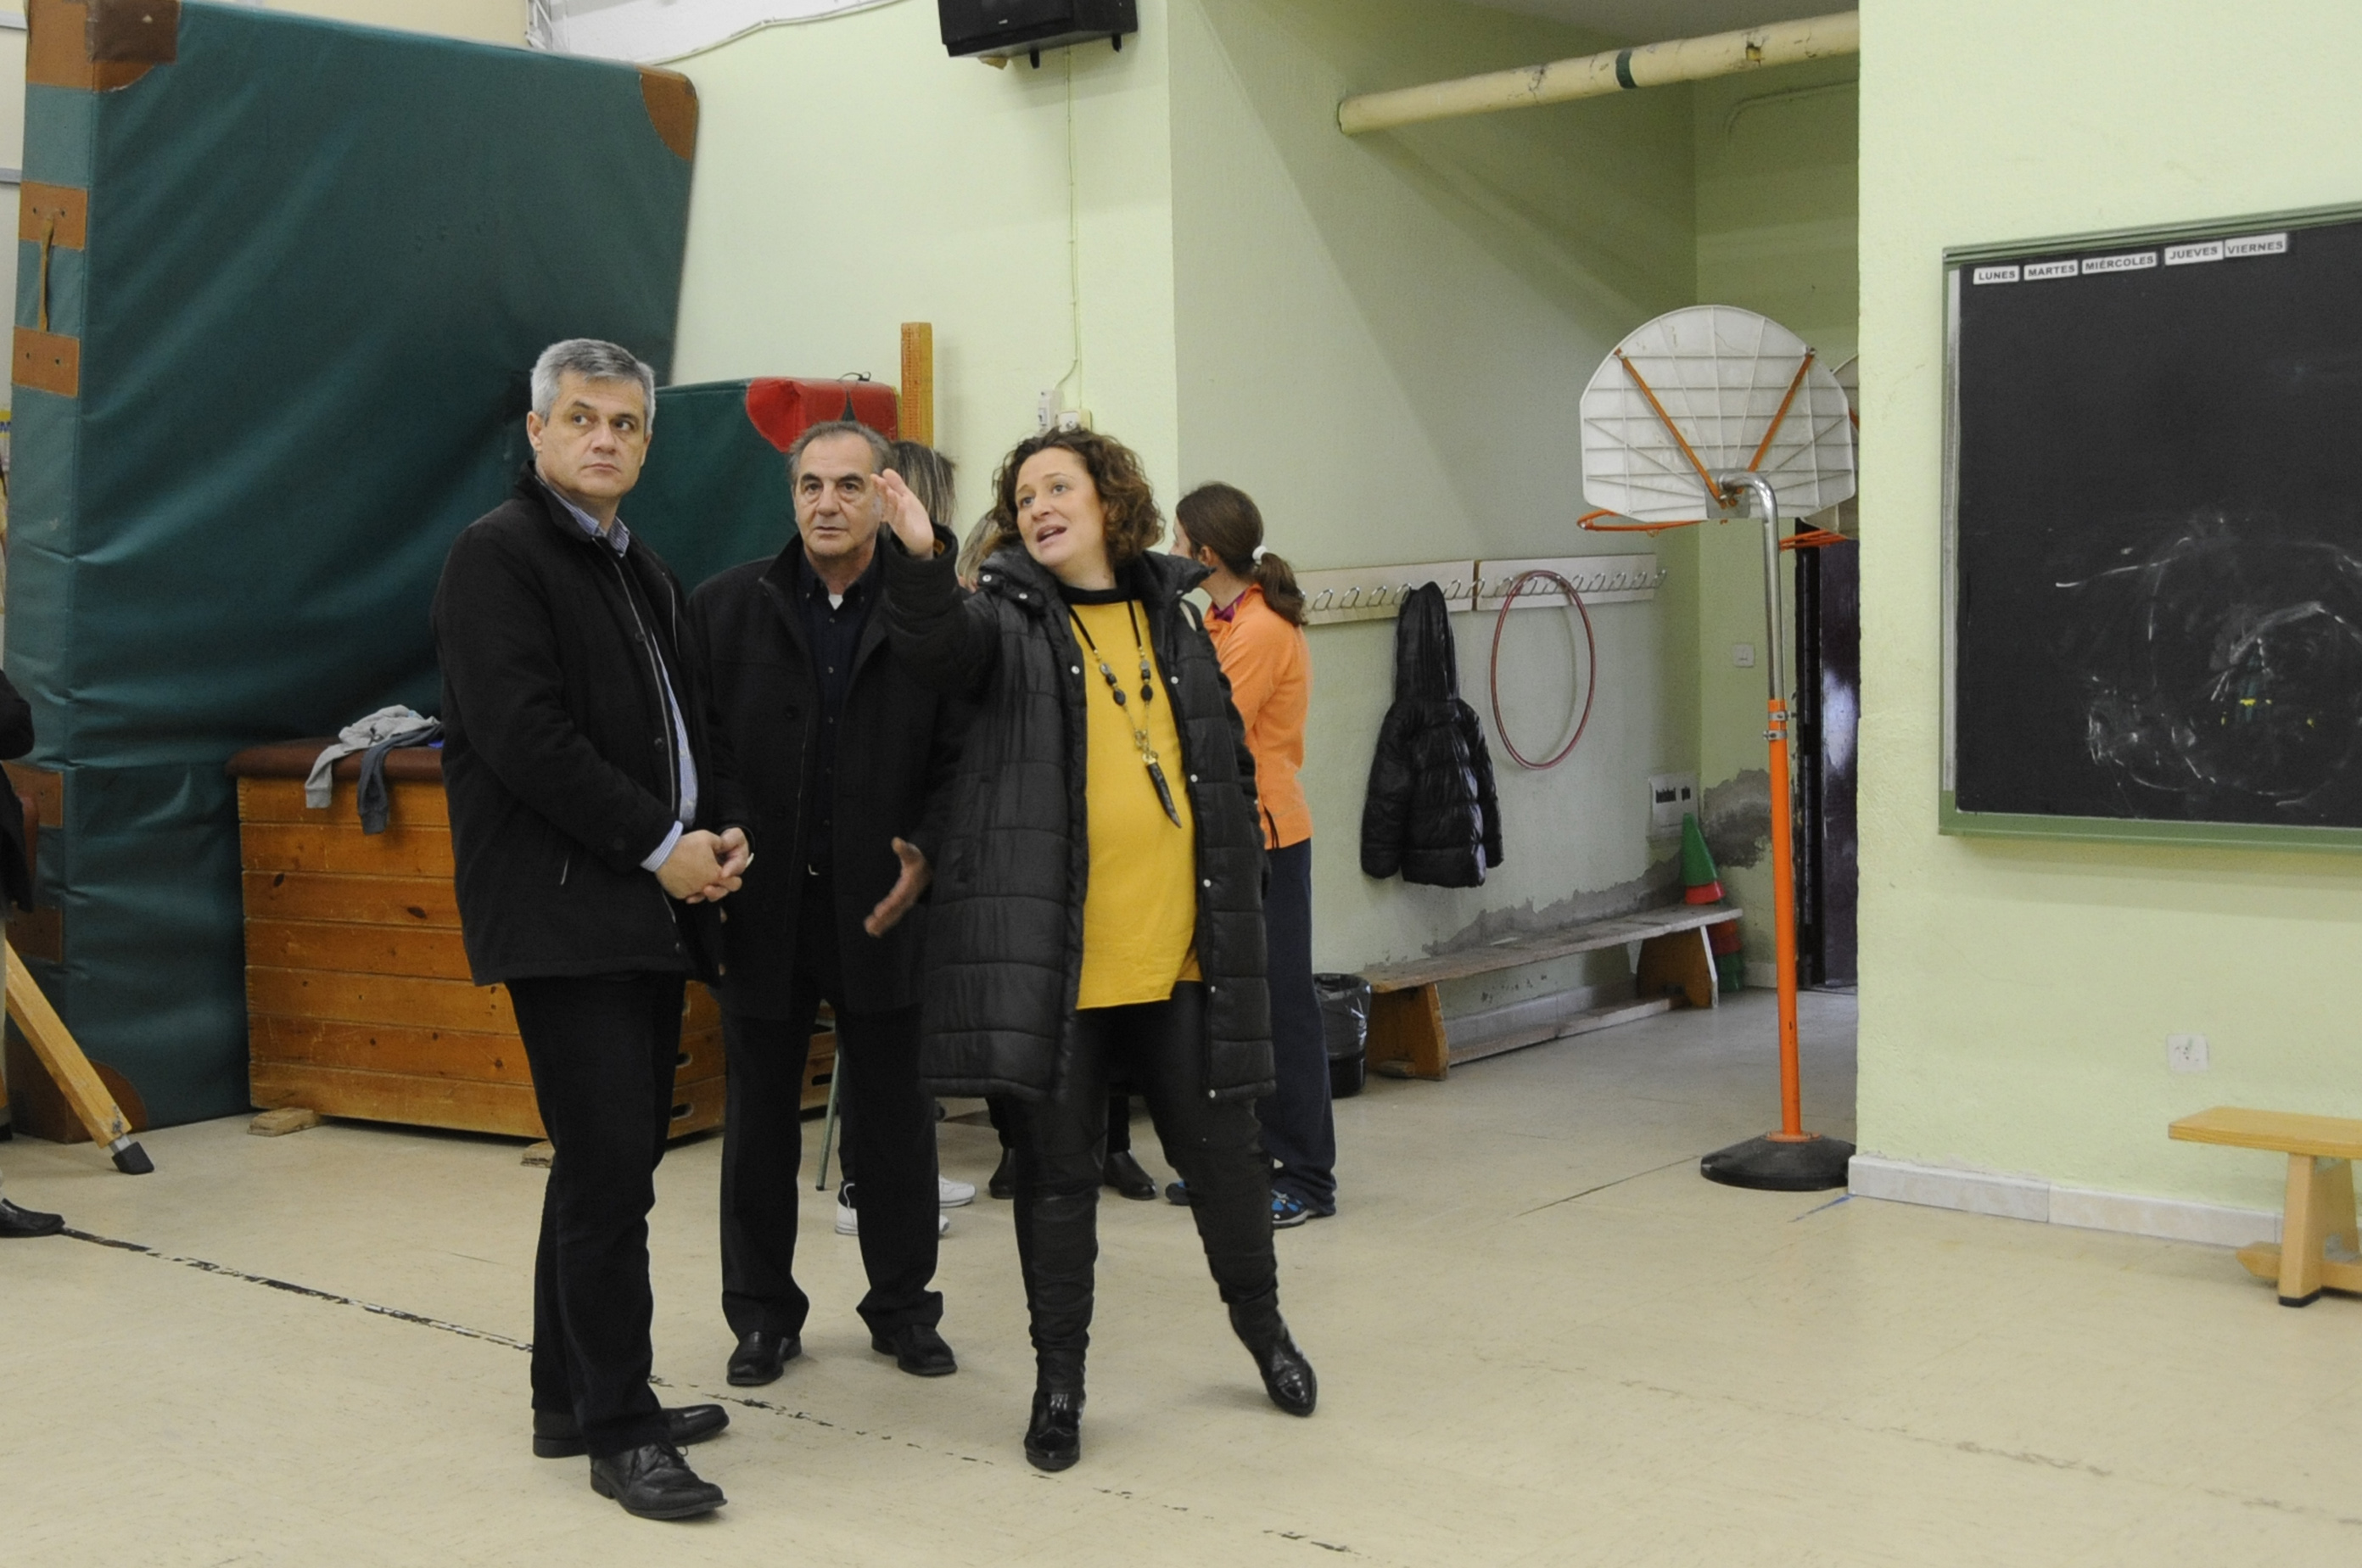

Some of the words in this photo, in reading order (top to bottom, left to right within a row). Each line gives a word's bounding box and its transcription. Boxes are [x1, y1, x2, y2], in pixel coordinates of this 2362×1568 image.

[1979, 271, 2016, 281] LUNES
[2028, 264, 2075, 277] MARTES
[2085, 255, 2155, 271] MIÉRCOLES
[2169, 246, 2219, 260] JUEVES
[2227, 241, 2283, 255] VIERNES
